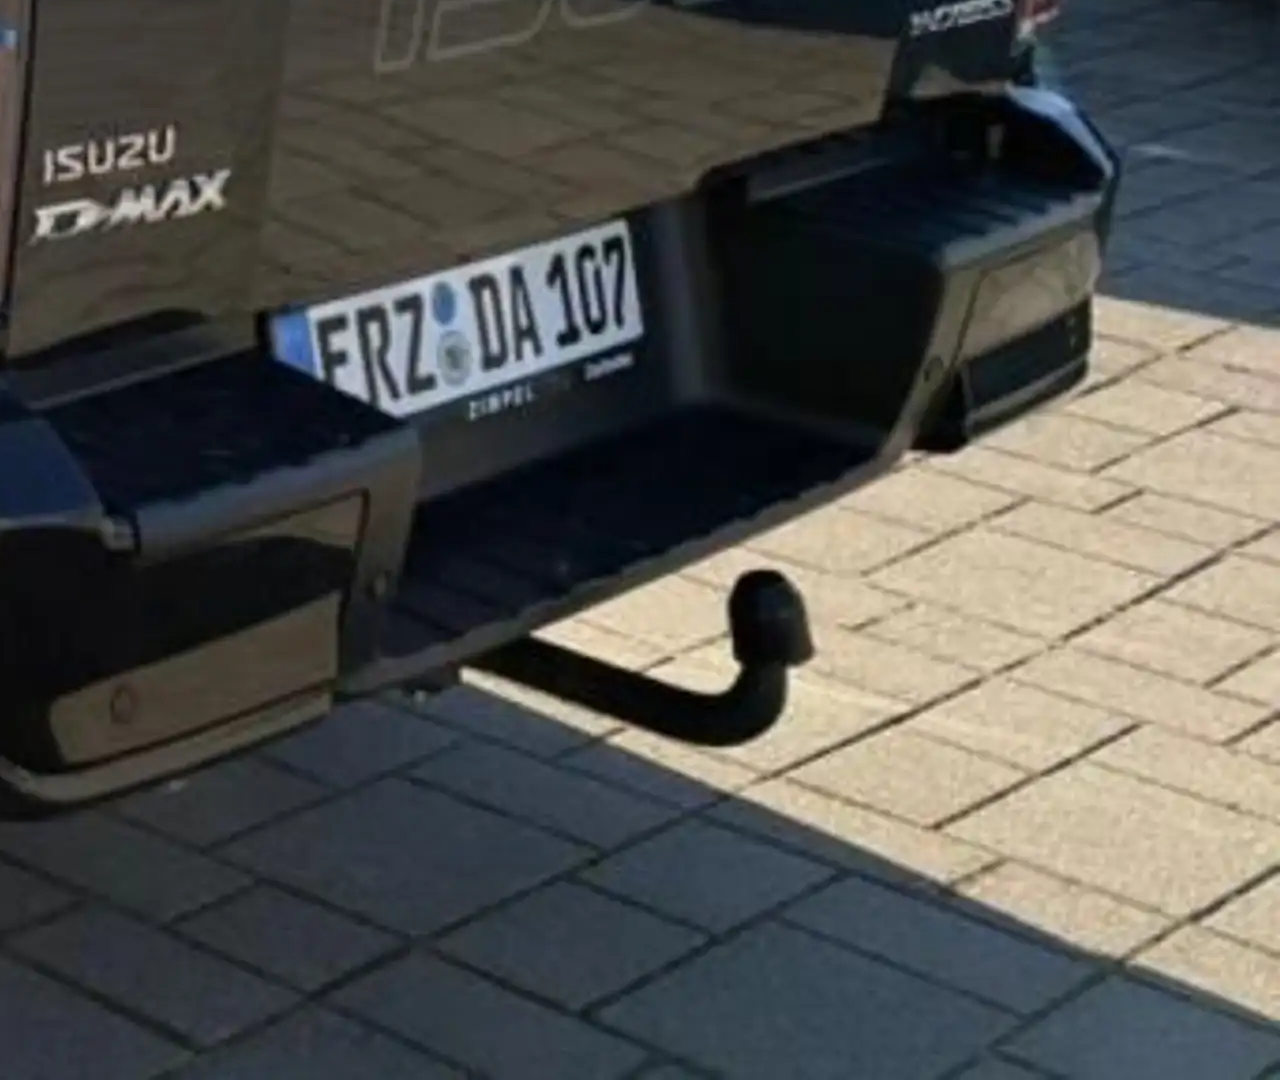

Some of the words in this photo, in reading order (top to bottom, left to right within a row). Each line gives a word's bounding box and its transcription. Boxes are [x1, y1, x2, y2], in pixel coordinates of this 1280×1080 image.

[44, 124, 176, 185] ISUZU
[468, 265, 544, 370] DA
[546, 235, 628, 346] 107
